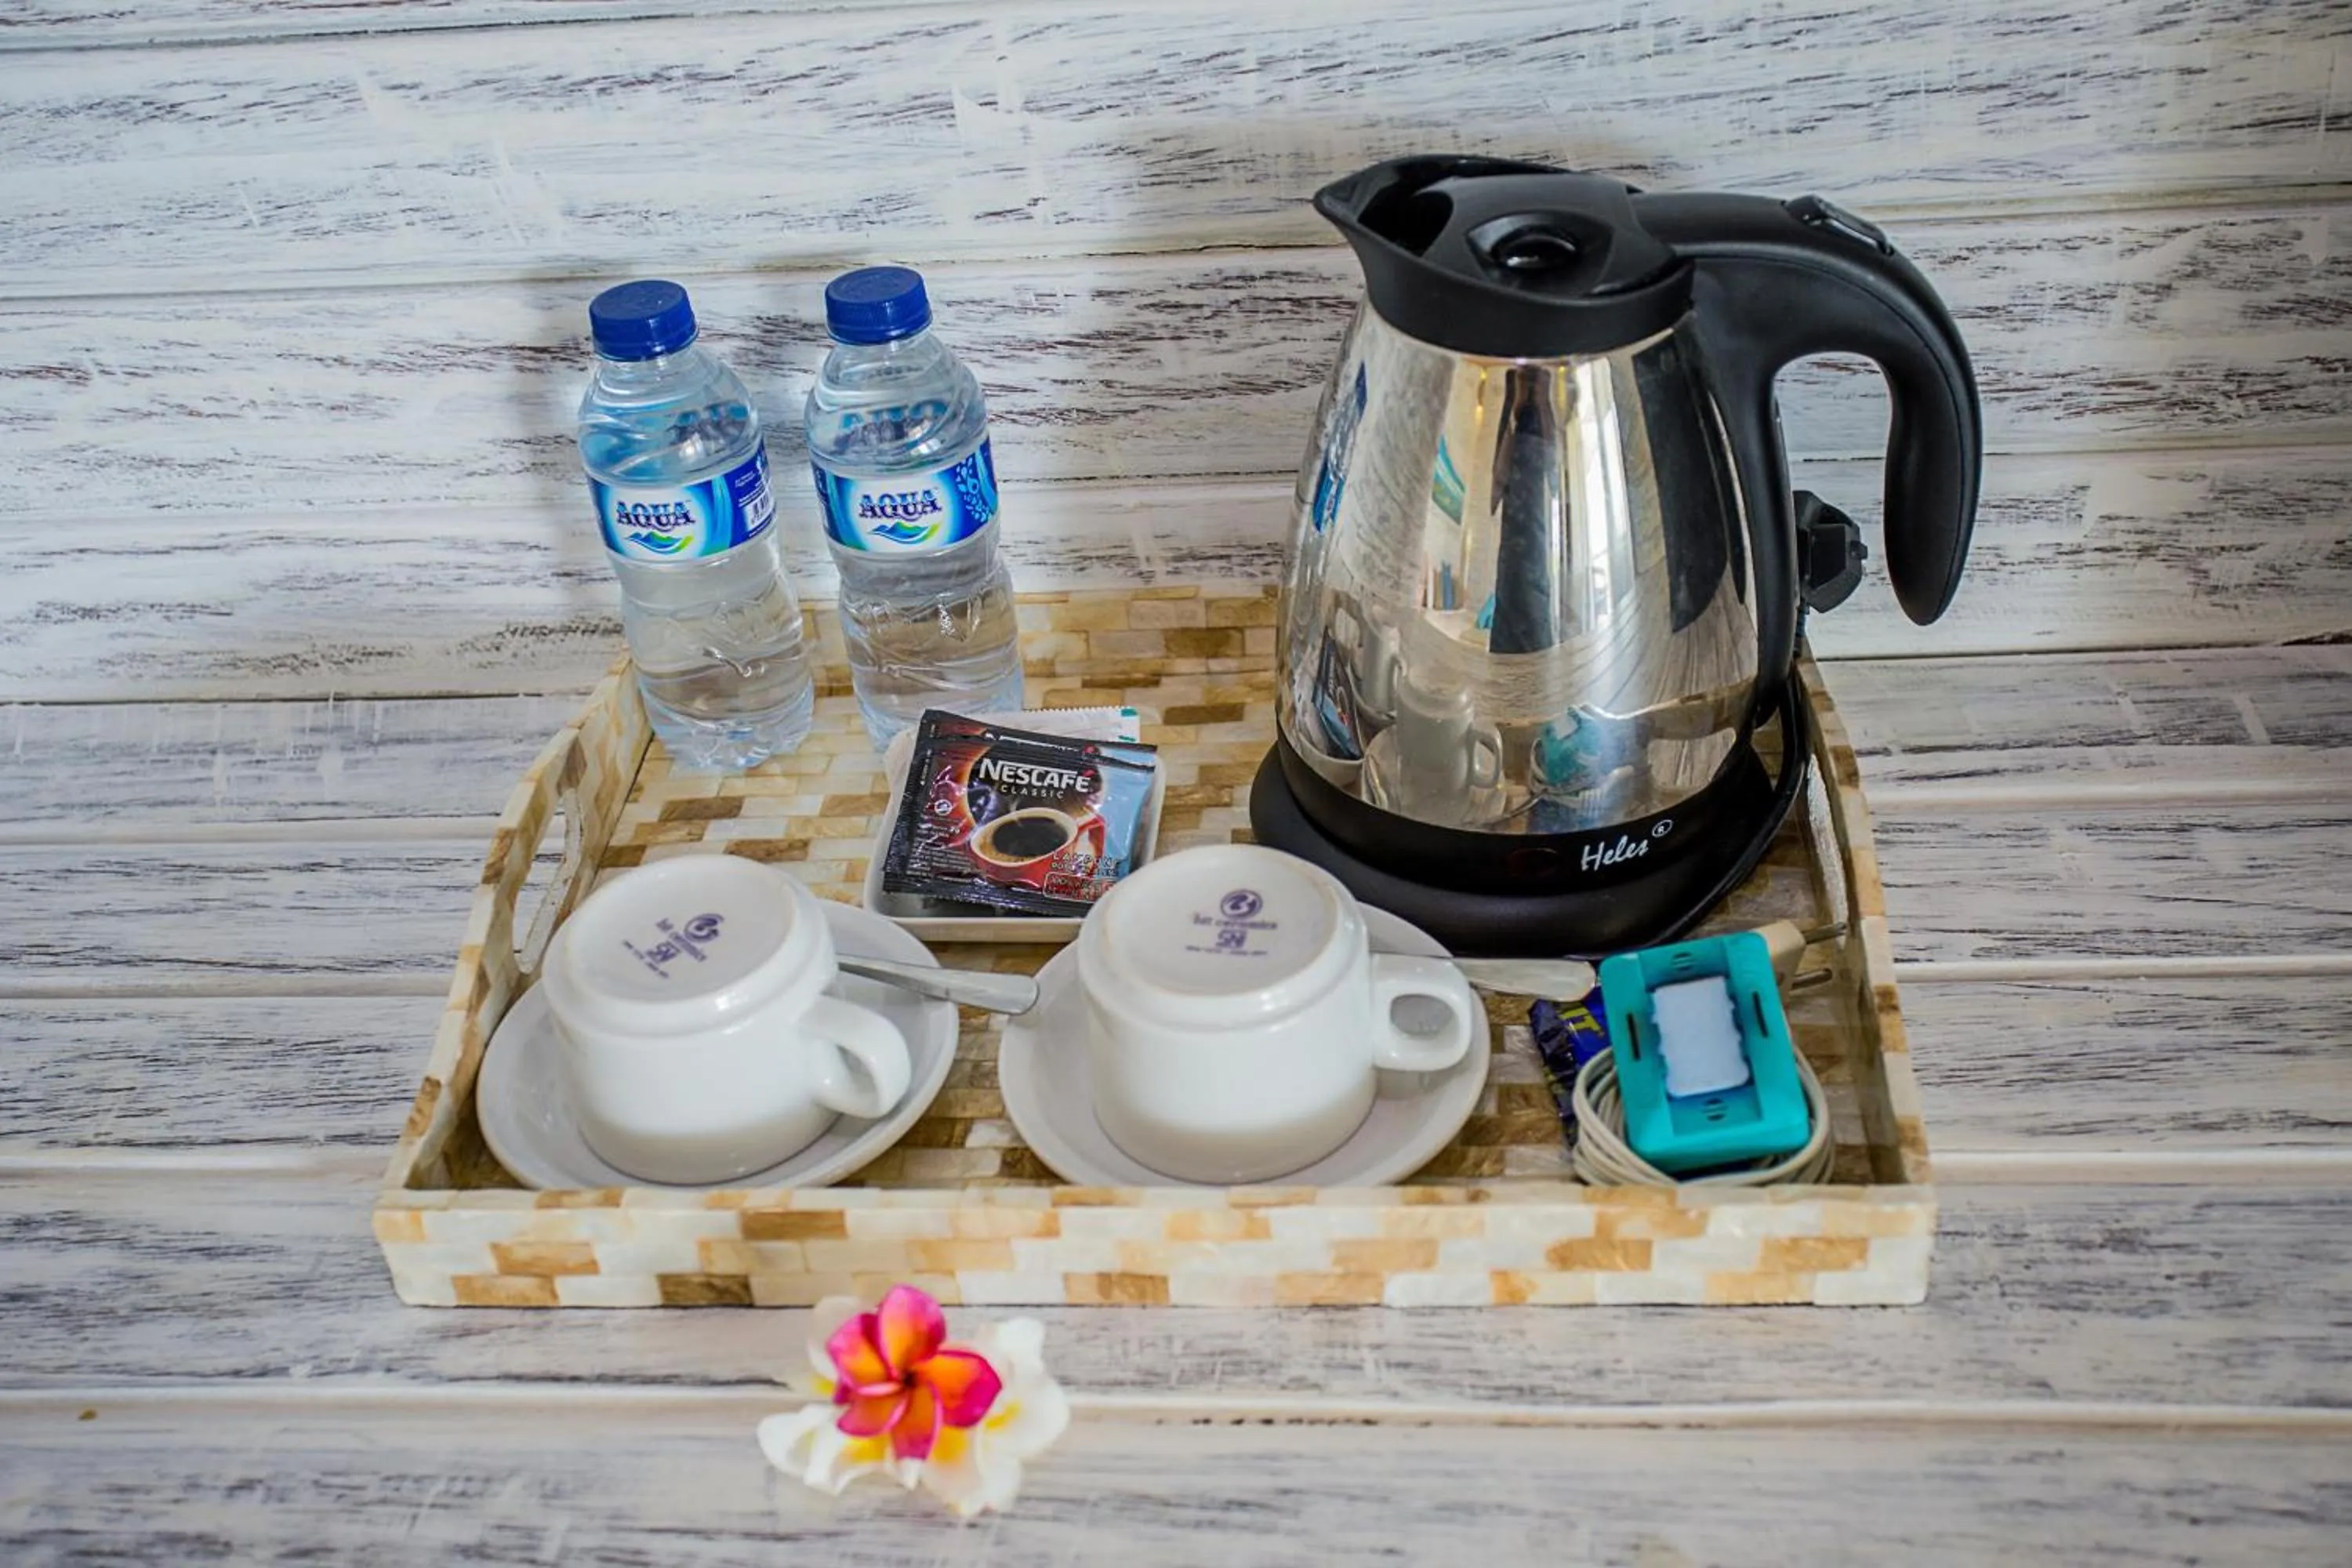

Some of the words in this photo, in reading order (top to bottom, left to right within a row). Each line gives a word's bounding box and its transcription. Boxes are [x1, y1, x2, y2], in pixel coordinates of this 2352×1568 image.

[615, 500, 696, 532] AQUA
[858, 490, 942, 521] AQUA
[1000, 785, 1065, 800] CLASSIC
